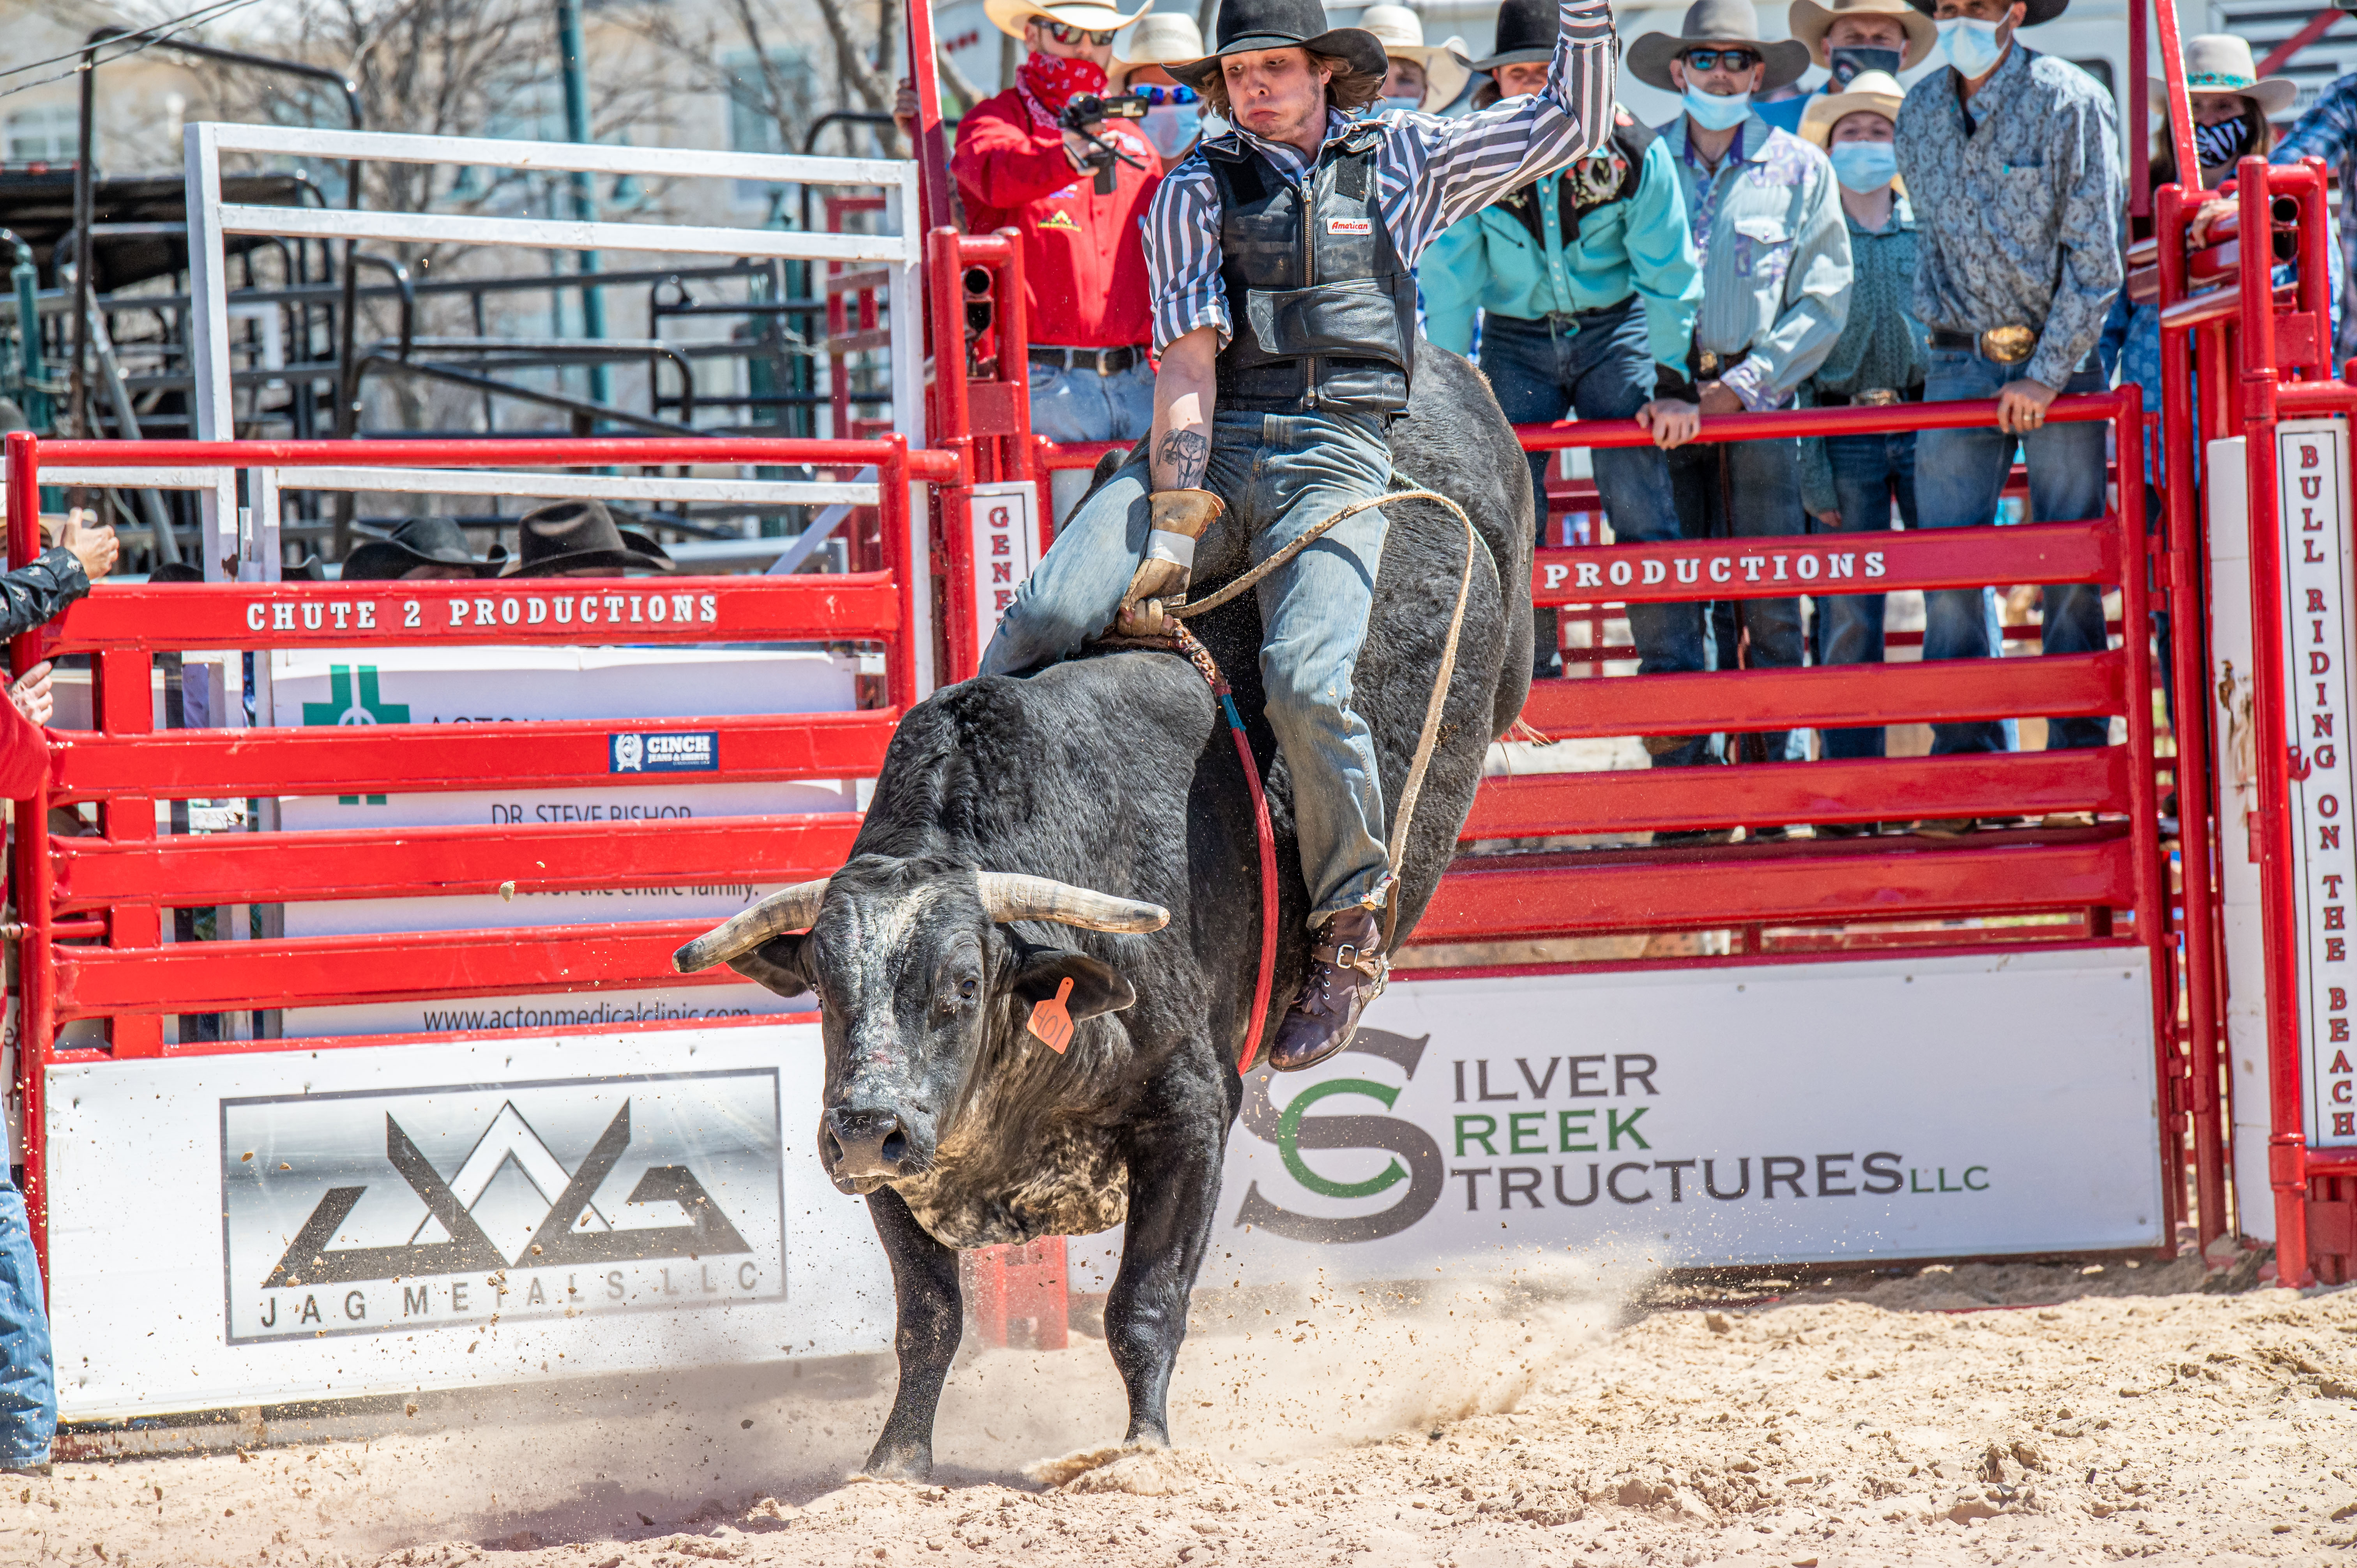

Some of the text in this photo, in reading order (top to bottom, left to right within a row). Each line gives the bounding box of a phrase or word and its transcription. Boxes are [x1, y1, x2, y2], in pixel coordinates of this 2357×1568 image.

[1332, 221, 1368, 230] American
[989, 506, 1013, 623] GENE
[1544, 551, 1886, 590] PRODUCTIONS
[247, 595, 717, 630] CHUTE 2 PRODUCTIONS
[647, 735, 710, 753] CINCH
[2300, 445, 2355, 1137] BULL RIDING ON THE BEACH
[1034, 1003, 1067, 1047] 401
[1454, 1053, 1660, 1103] ILVER
[1455, 1108, 1652, 1157] REEK
[1450, 1151, 1990, 1212] TRUCTURES LLC
[260, 1261, 757, 1328] JAG METALS LLC
